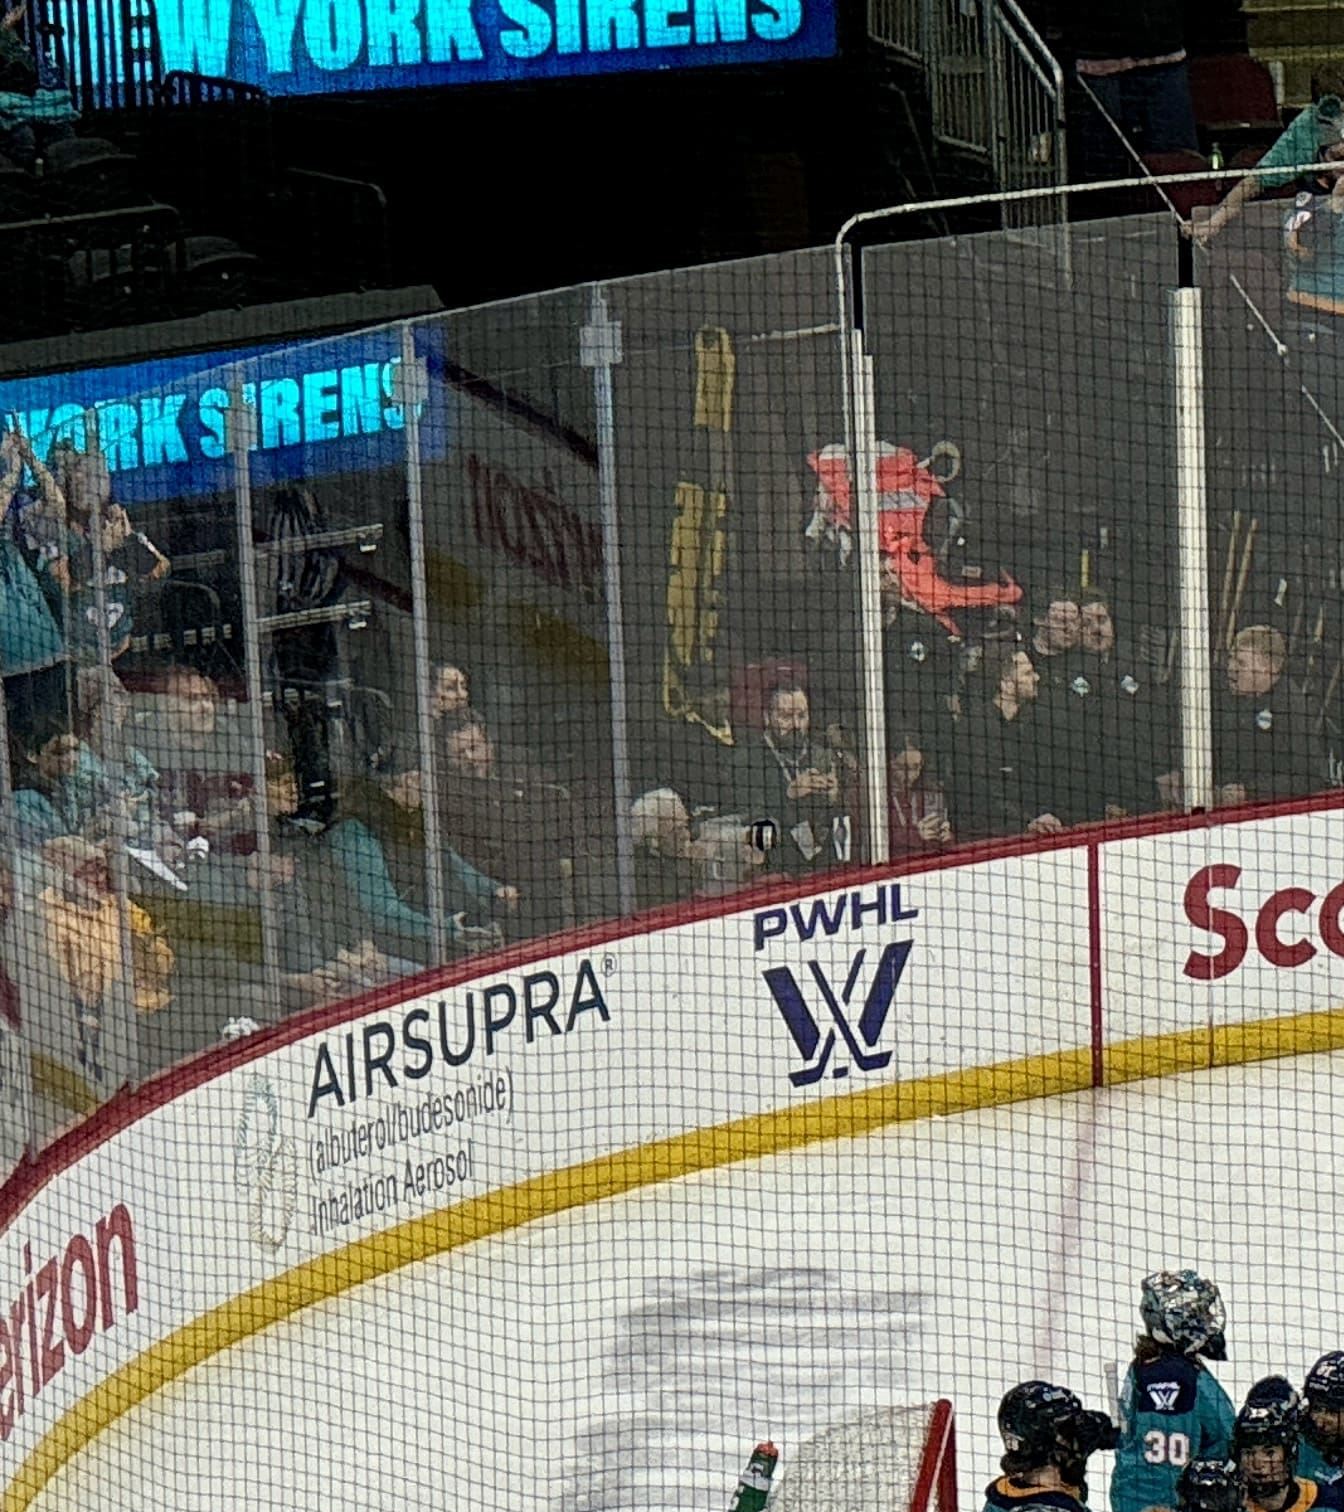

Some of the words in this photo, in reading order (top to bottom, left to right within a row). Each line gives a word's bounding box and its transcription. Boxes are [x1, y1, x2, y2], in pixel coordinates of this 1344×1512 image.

[247, 0, 484, 74] YORK
[499, 0, 803, 60] SIRENS
[754, 884, 919, 951] PWHL
[309, 1066, 515, 1186] (albuterol/budesonide)
[403, 1137, 474, 1202] Aerosol
[1143, 1430, 1190, 1465] 30
